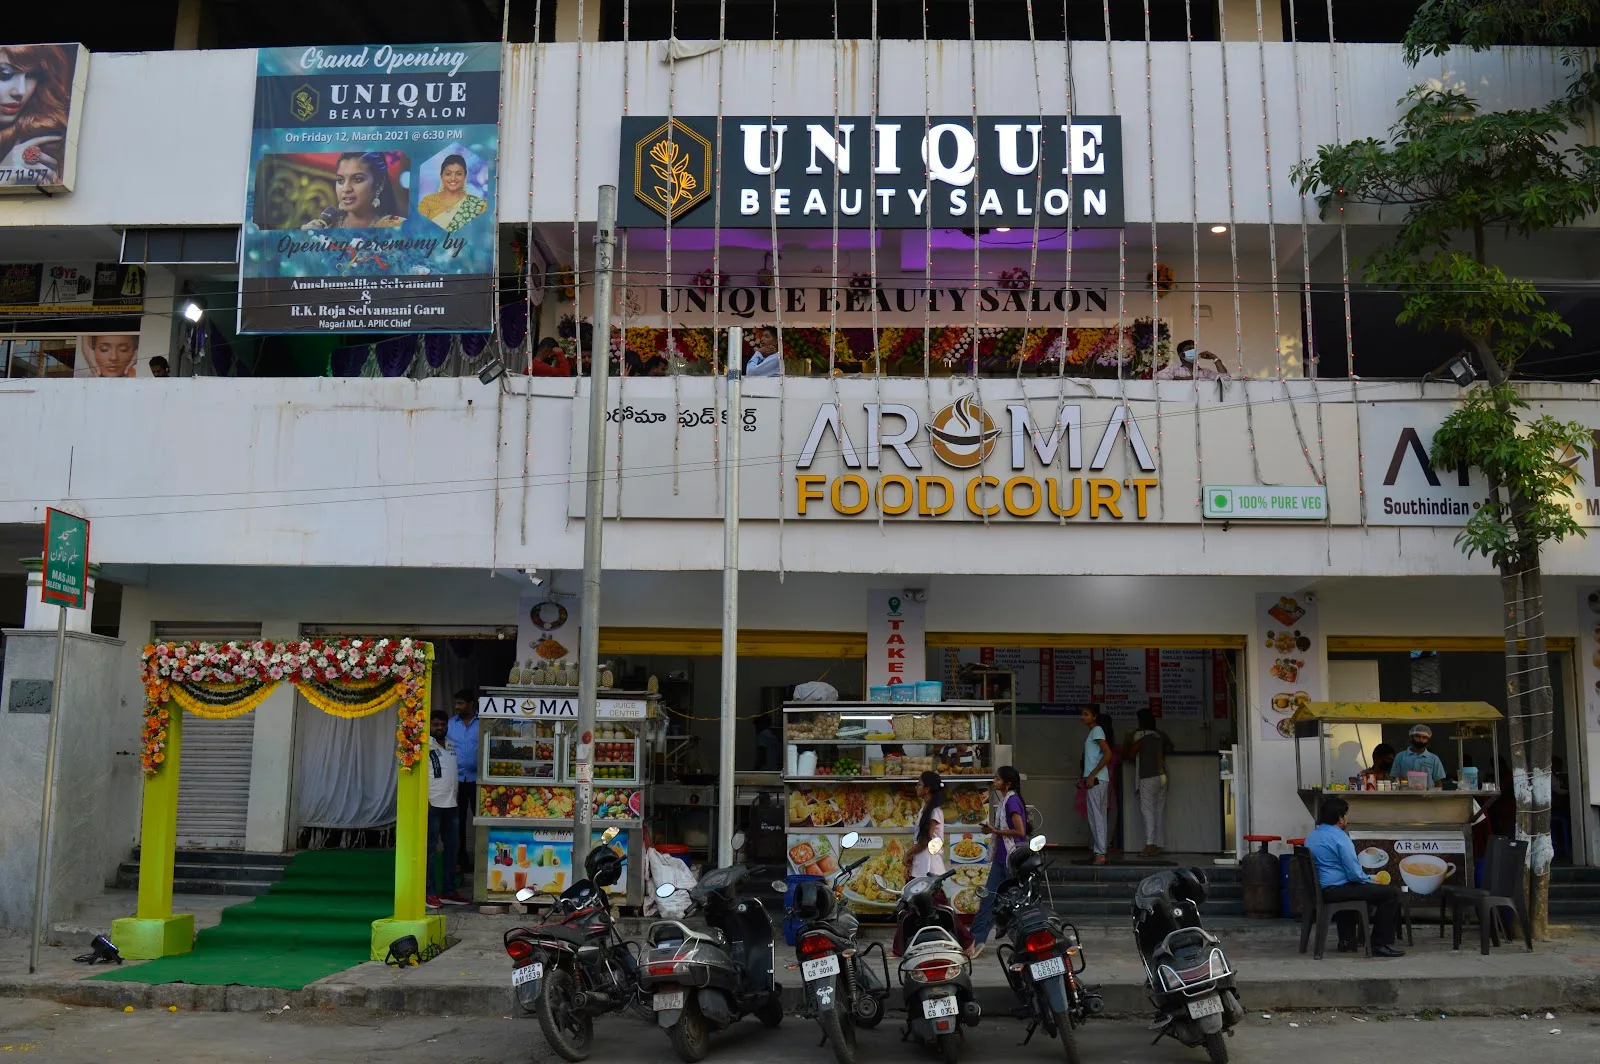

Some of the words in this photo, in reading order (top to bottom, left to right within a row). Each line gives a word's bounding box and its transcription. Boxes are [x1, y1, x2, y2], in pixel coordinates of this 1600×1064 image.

[299, 46, 370, 70] Grand
[373, 45, 469, 77] Opening
[330, 82, 467, 107] UNIQUE
[329, 108, 401, 120] BEAUTY
[406, 107, 467, 118] SALON
[285, 133, 300, 142] On
[301, 131, 333, 145] Friday
[335, 131, 350, 143] 12,
[351, 130, 382, 141] March
[384, 130, 410, 141] 2021
[411, 131, 421, 141] @
[422, 129, 445, 141] 6:30
[446, 129, 464, 139] PM
[740, 122, 1106, 187] UNIQUE
[15, 169, 25, 181] 11
[27, 168, 49, 181] 977
[740, 188, 928, 217] BEAUTY
[949, 188, 1108, 217] SALON
[277, 235, 350, 260] Opening
[354, 235, 440, 258] ceremony
[441, 231, 467, 258] by
[380, 278, 444, 289] Selvamani
[361, 290, 372, 305] &
[659, 288, 806, 318] UNIQUE
[817, 287, 969, 313] BEAUTY
[978, 287, 1109, 313] SALON
[291, 306, 317, 317] R.K.
[319, 305, 346, 319] Roja
[348, 304, 412, 317] Selvamani
[414, 304, 445, 316] Garu
[319, 319, 345, 330] Nagari
[390, 318, 412, 328] Chief
[796, 392, 1156, 471] AROMA
[795, 474, 954, 517] FOOD
[966, 474, 1158, 519] COURT
[1238, 495, 1268, 509] 100%
[1271, 496, 1298, 509] PURE
[1302, 496, 1321, 509] VEG
[1383, 497, 1470, 515] Southindian
[57, 526, 78, 546] مسجد
[51, 569, 77, 586] MASJID
[886, 619, 906, 687] TAKEA
[483, 697, 575, 716] AROMA
[1396, 842, 1439, 850] AROMA
[520, 965, 536, 975] AP22
